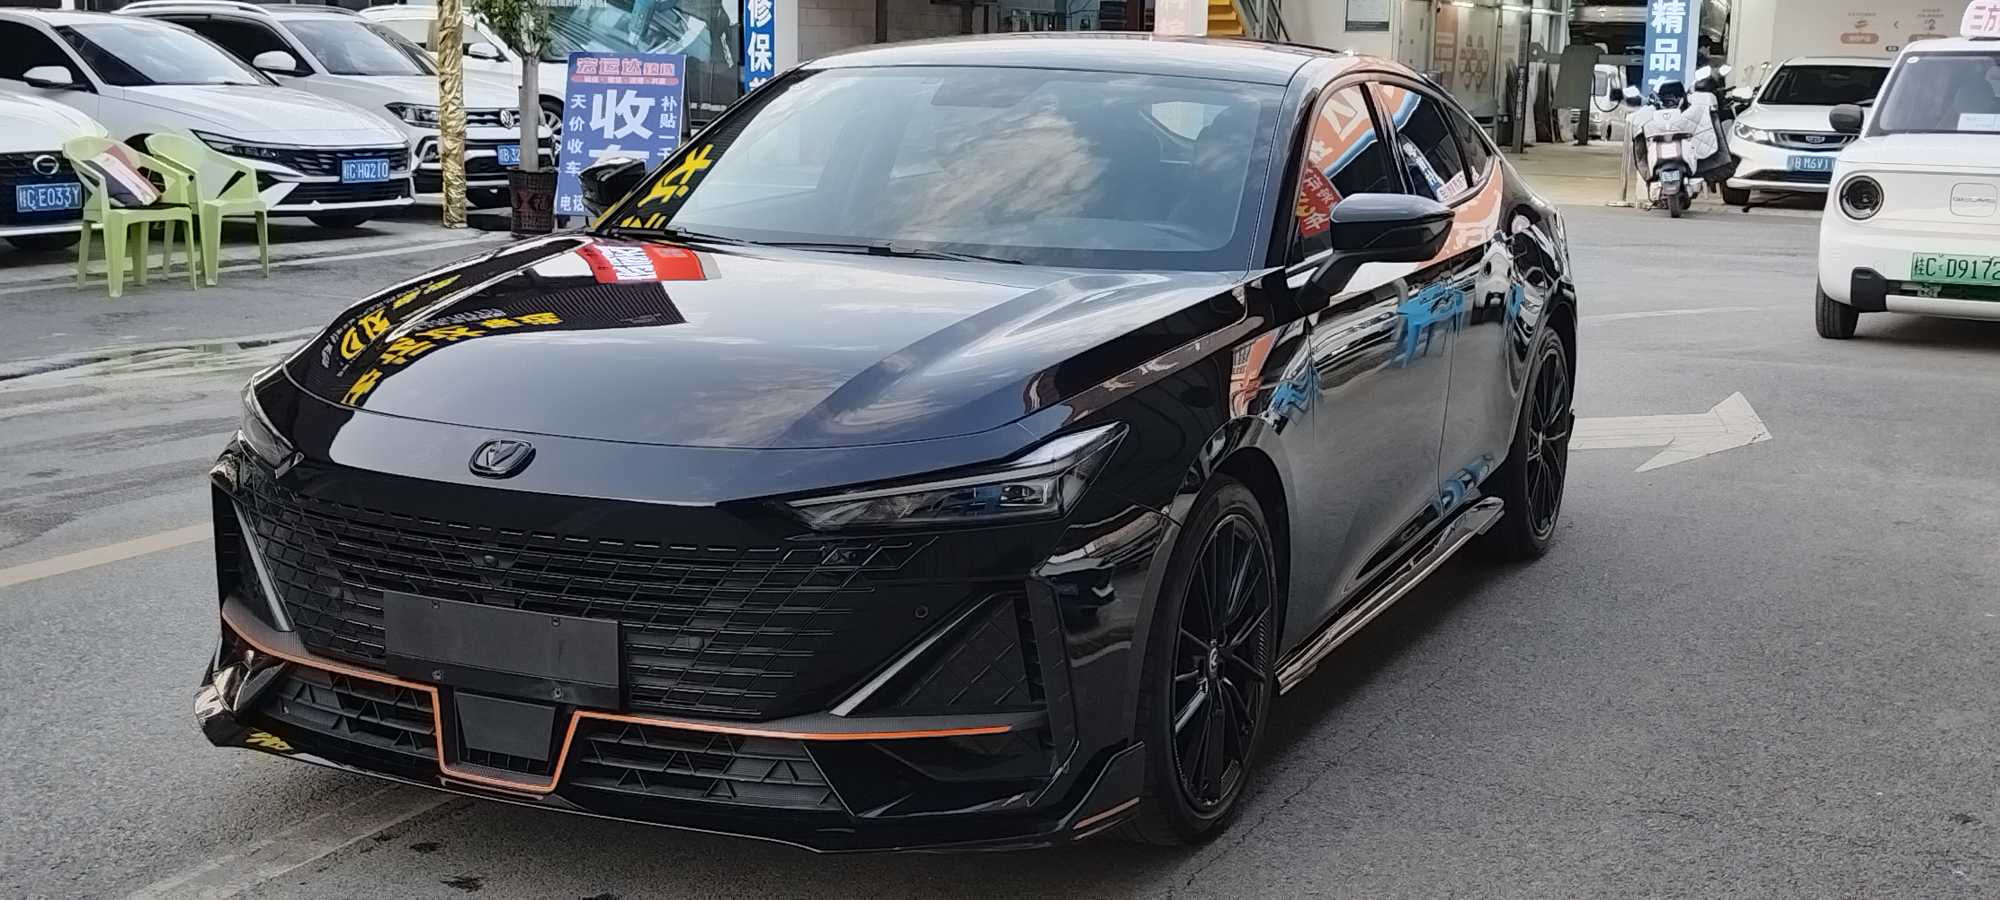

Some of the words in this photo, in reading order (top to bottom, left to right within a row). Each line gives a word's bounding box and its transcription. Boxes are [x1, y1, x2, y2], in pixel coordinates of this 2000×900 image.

[747, 0, 772, 92] 修保
[565, 94, 586, 177] 天价收车
